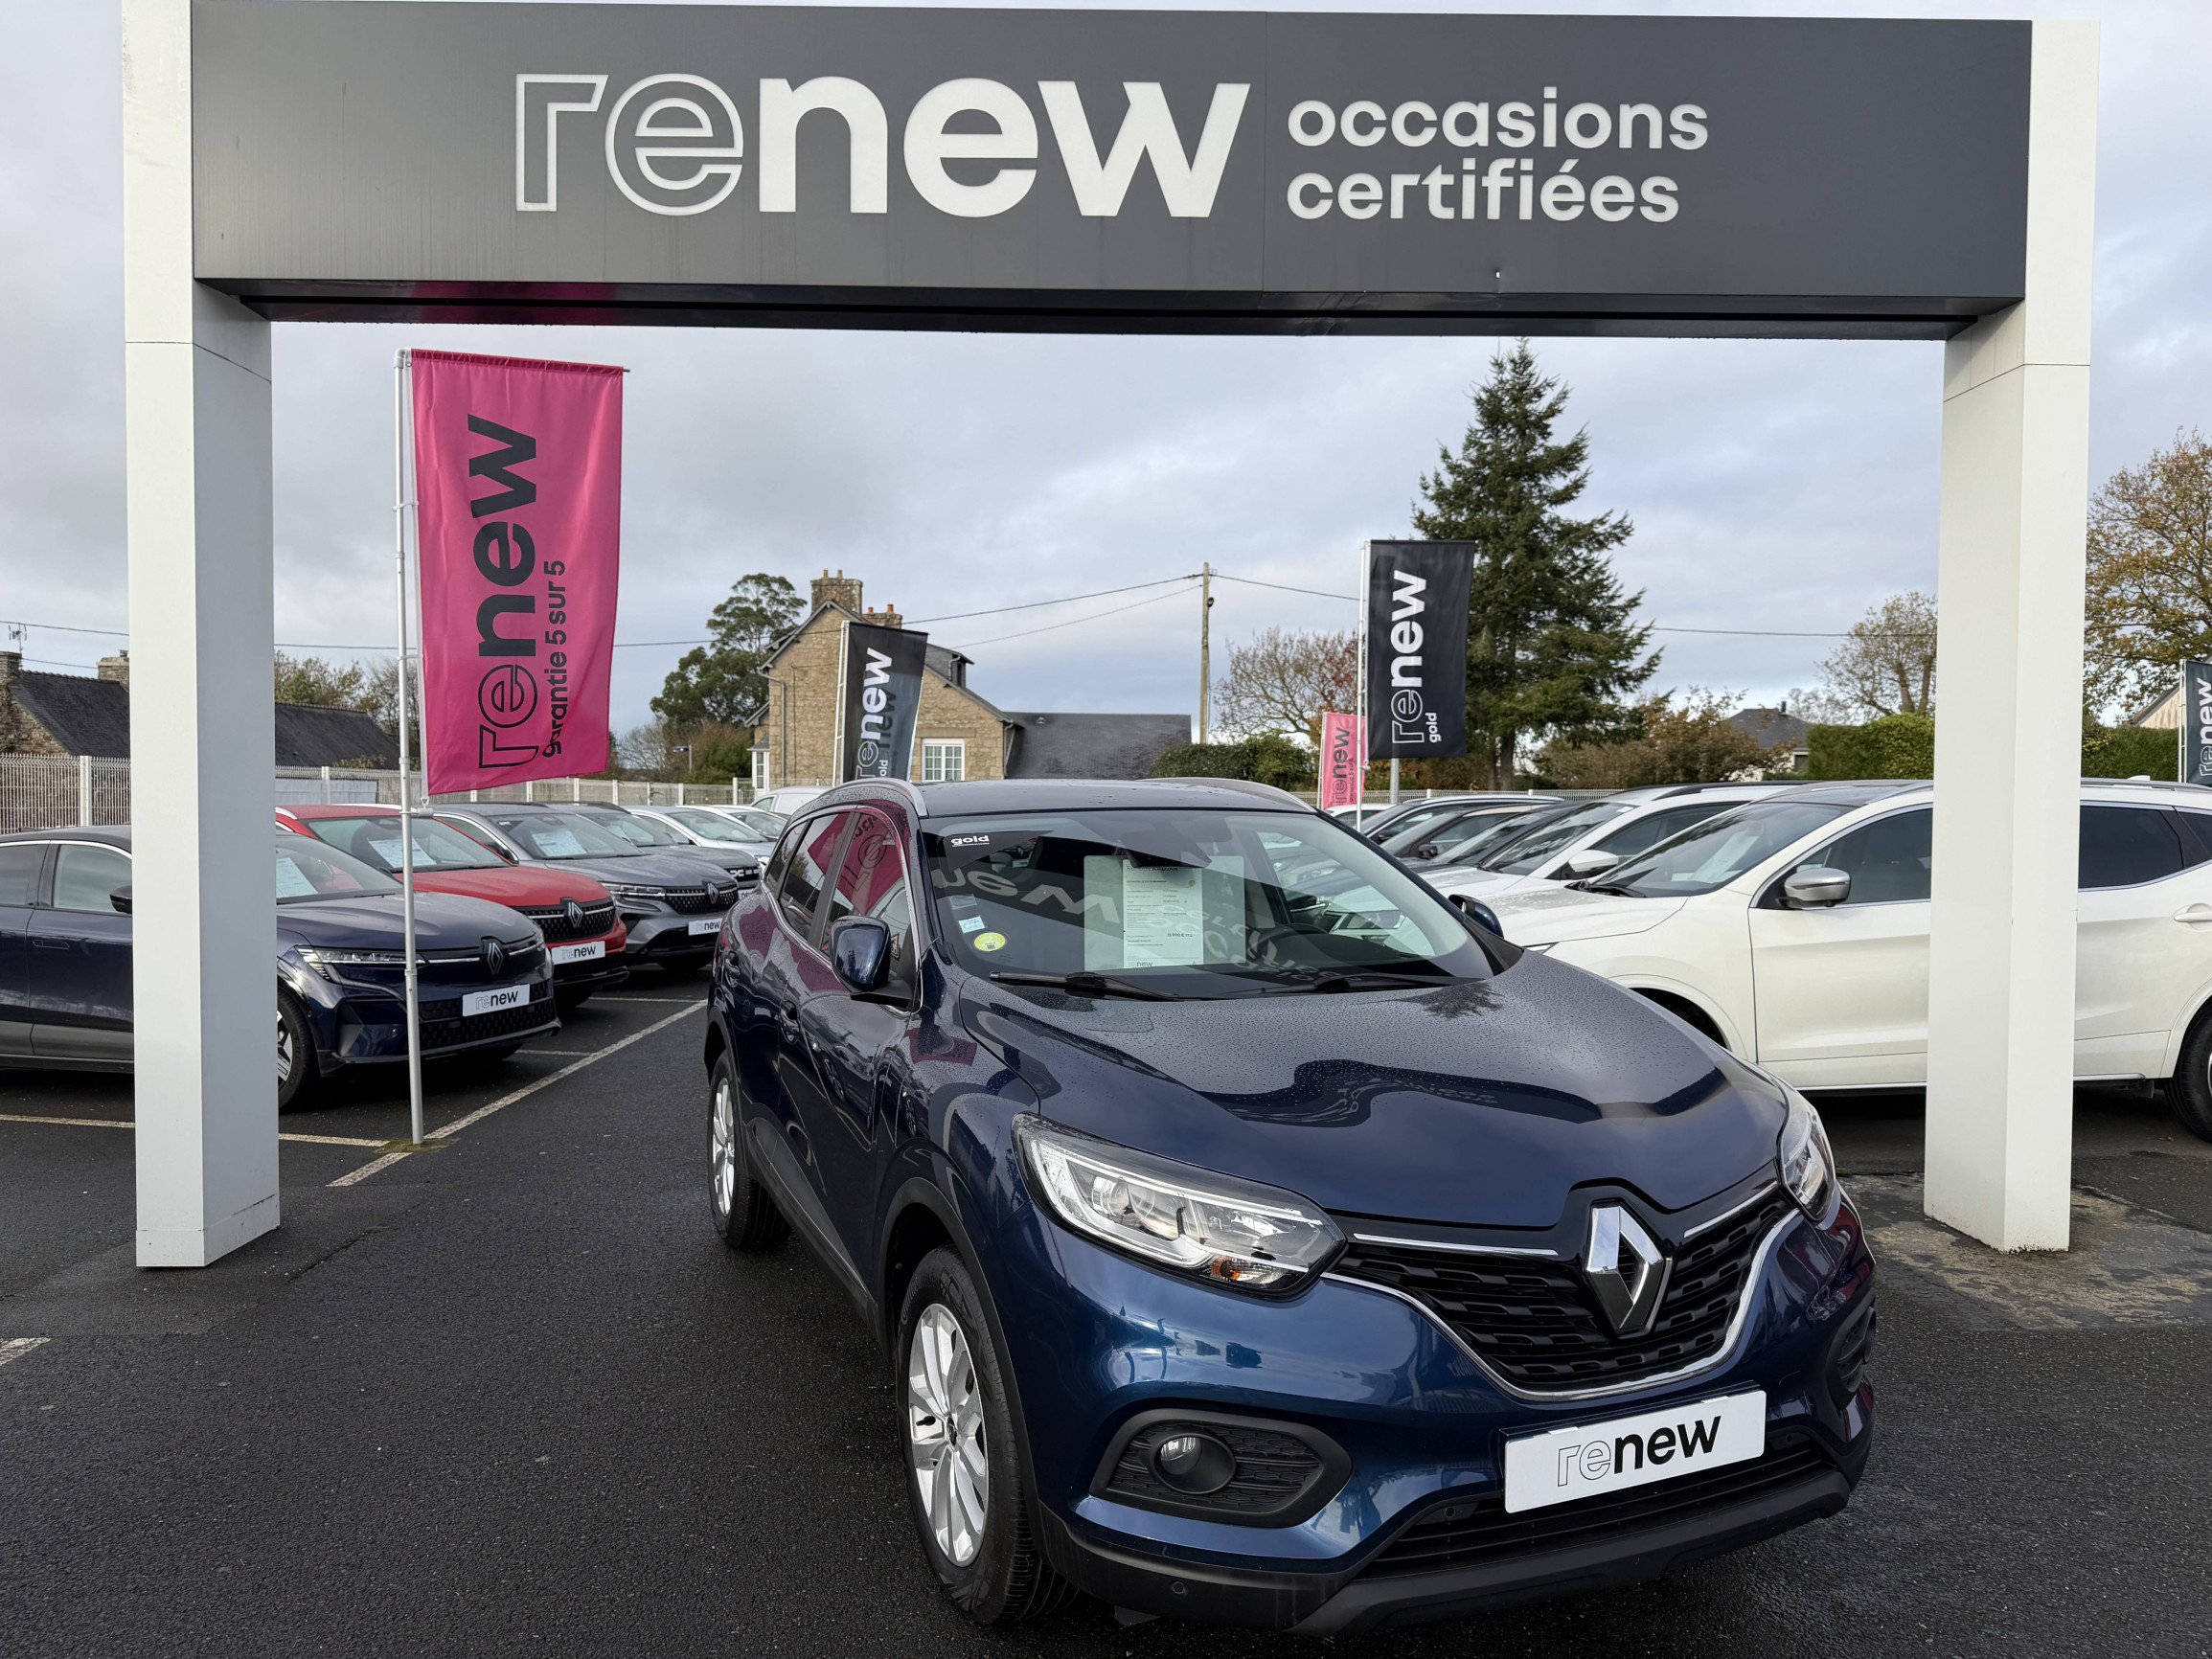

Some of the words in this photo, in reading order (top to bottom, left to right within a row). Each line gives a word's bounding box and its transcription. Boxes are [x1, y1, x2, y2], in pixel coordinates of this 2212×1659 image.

[515, 73, 1251, 217] renew
[1288, 86, 1709, 150] occasions
[1287, 157, 1679, 222] certifiées
[467, 414, 539, 768] renew
[543, 560, 565, 576] 5
[548, 580, 566, 625] sur
[544, 628, 566, 645] 5
[1390, 569, 1427, 743] renew
[542, 651, 568, 758] garantie
[855, 647, 893, 780] renew
[1425, 712, 1442, 742] gold
[878, 760, 888, 777] old
[1332, 727, 1350, 803] renew
[950, 835, 989, 846] gold
[561, 945, 597, 961] renew
[475, 990, 518, 1011] renew
[1557, 1415, 1722, 1487] renew
